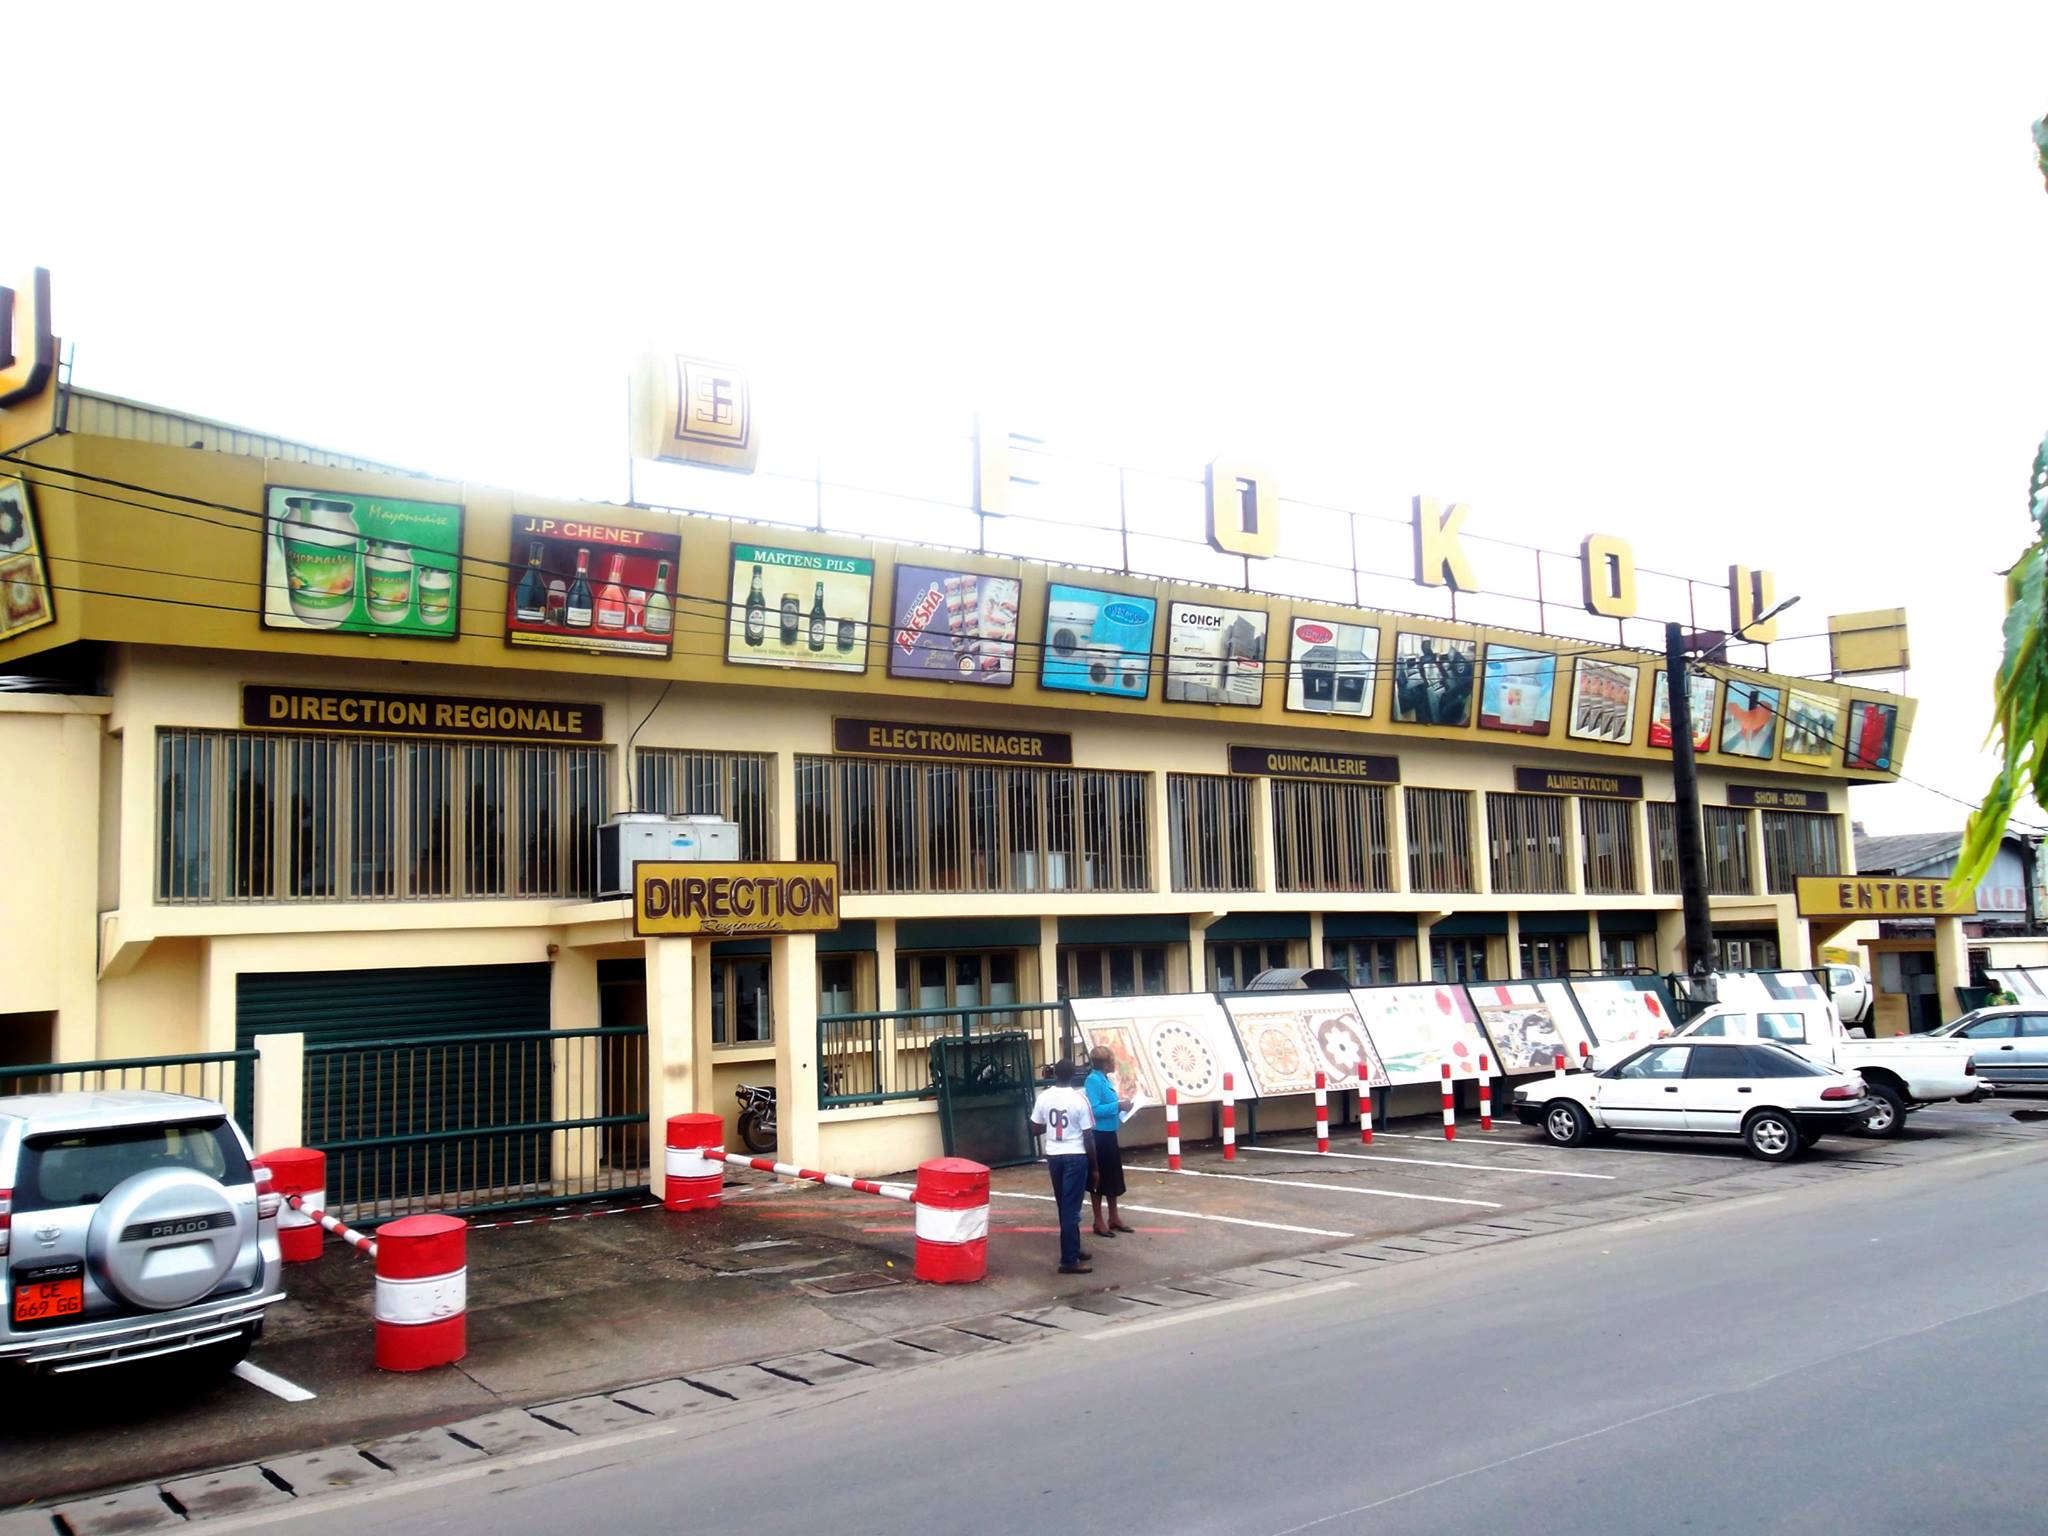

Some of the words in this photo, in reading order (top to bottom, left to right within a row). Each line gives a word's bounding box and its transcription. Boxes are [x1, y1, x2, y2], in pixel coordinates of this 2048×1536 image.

[525, 518, 559, 535] J.P.
[562, 522, 645, 545] CHENET
[754, 550, 822, 569] MARTENS
[825, 559, 856, 573] PILS
[895, 588, 945, 657] FRESHA
[1181, 613, 1221, 627] CONCH
[269, 694, 427, 726] DIRECTION
[435, 704, 583, 734] REGIONALE
[868, 727, 1043, 757] ELECTROMENAGER
[1266, 753, 1368, 776] QUINCAILLERIE
[1546, 774, 1619, 793] ALIMENTATION
[644, 876, 835, 919] DIRECTION
[1838, 882, 1945, 910] ENTREE
[151, 1219, 209, 1237] PRADO
[39, 1283, 62, 1299] CE
[17, 1301, 49, 1319] 669
[56, 1296, 79, 1313] GG
